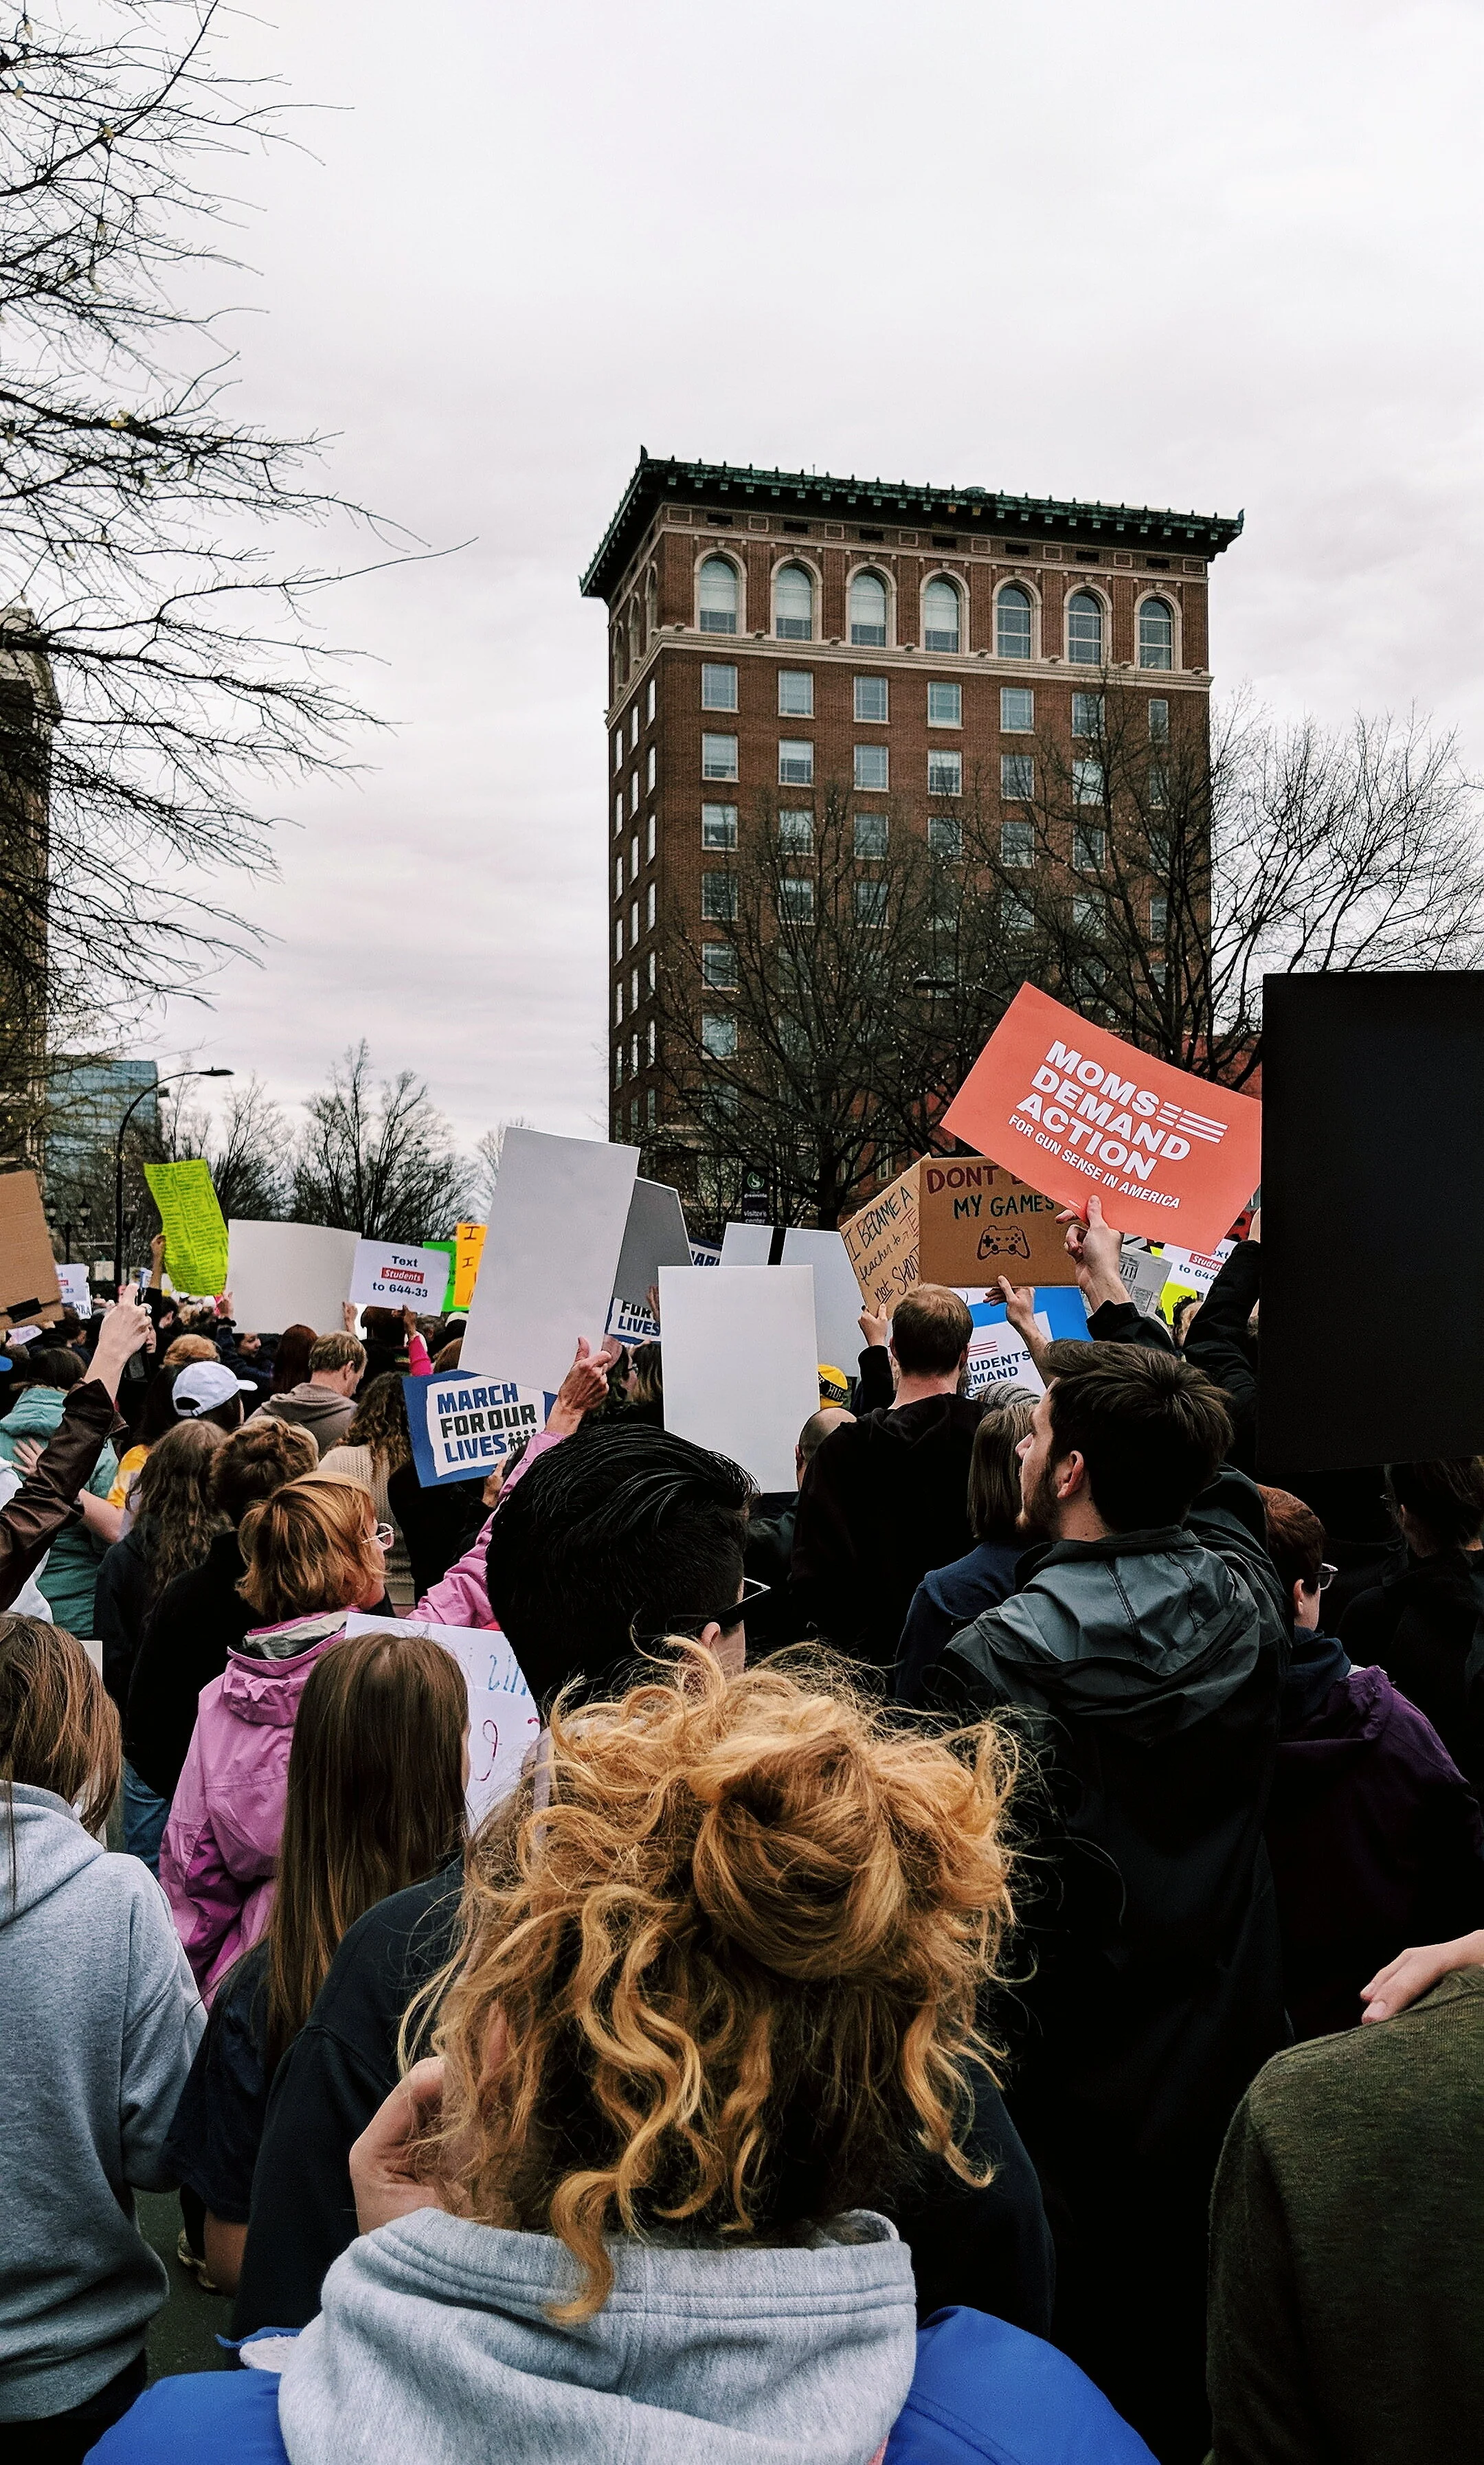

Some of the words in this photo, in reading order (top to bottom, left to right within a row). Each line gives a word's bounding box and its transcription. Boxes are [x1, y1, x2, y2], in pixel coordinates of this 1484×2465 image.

[1044, 1039, 1160, 1117] MOMS
[1031, 1064, 1191, 1161] DEMAND
[1015, 1092, 1158, 1182] ACTION
[1008, 1114, 1035, 1138] FOR
[1034, 1132, 1062, 1156] GUN
[1061, 1149, 1103, 1182] SENSE
[1102, 1172, 1121, 1189] IN
[1118, 1181, 1180, 1209] AMERICA
[927, 1165, 999, 1194] DONT
[954, 1194, 982, 1219] MY
[991, 1195, 1055, 1217] GAMES
[844, 1228, 861, 1261] I
[856, 1193, 901, 1249] BECAME
[899, 1185, 914, 1208] A
[384, 1269, 422, 1282] Students
[392, 1255, 418, 1268] Text
[858, 1243, 893, 1287] teacher
[1179, 1263, 1191, 1274] to
[372, 1282, 385, 1291] to
[874, 1278, 892, 1303] not
[618, 1315, 660, 1337] LIVES
[437, 1382, 519, 1415] MARCH
[440, 1412, 486, 1439] FOR
[487, 1404, 537, 1430] OUR
[444, 1433, 507, 1463] LIVES
